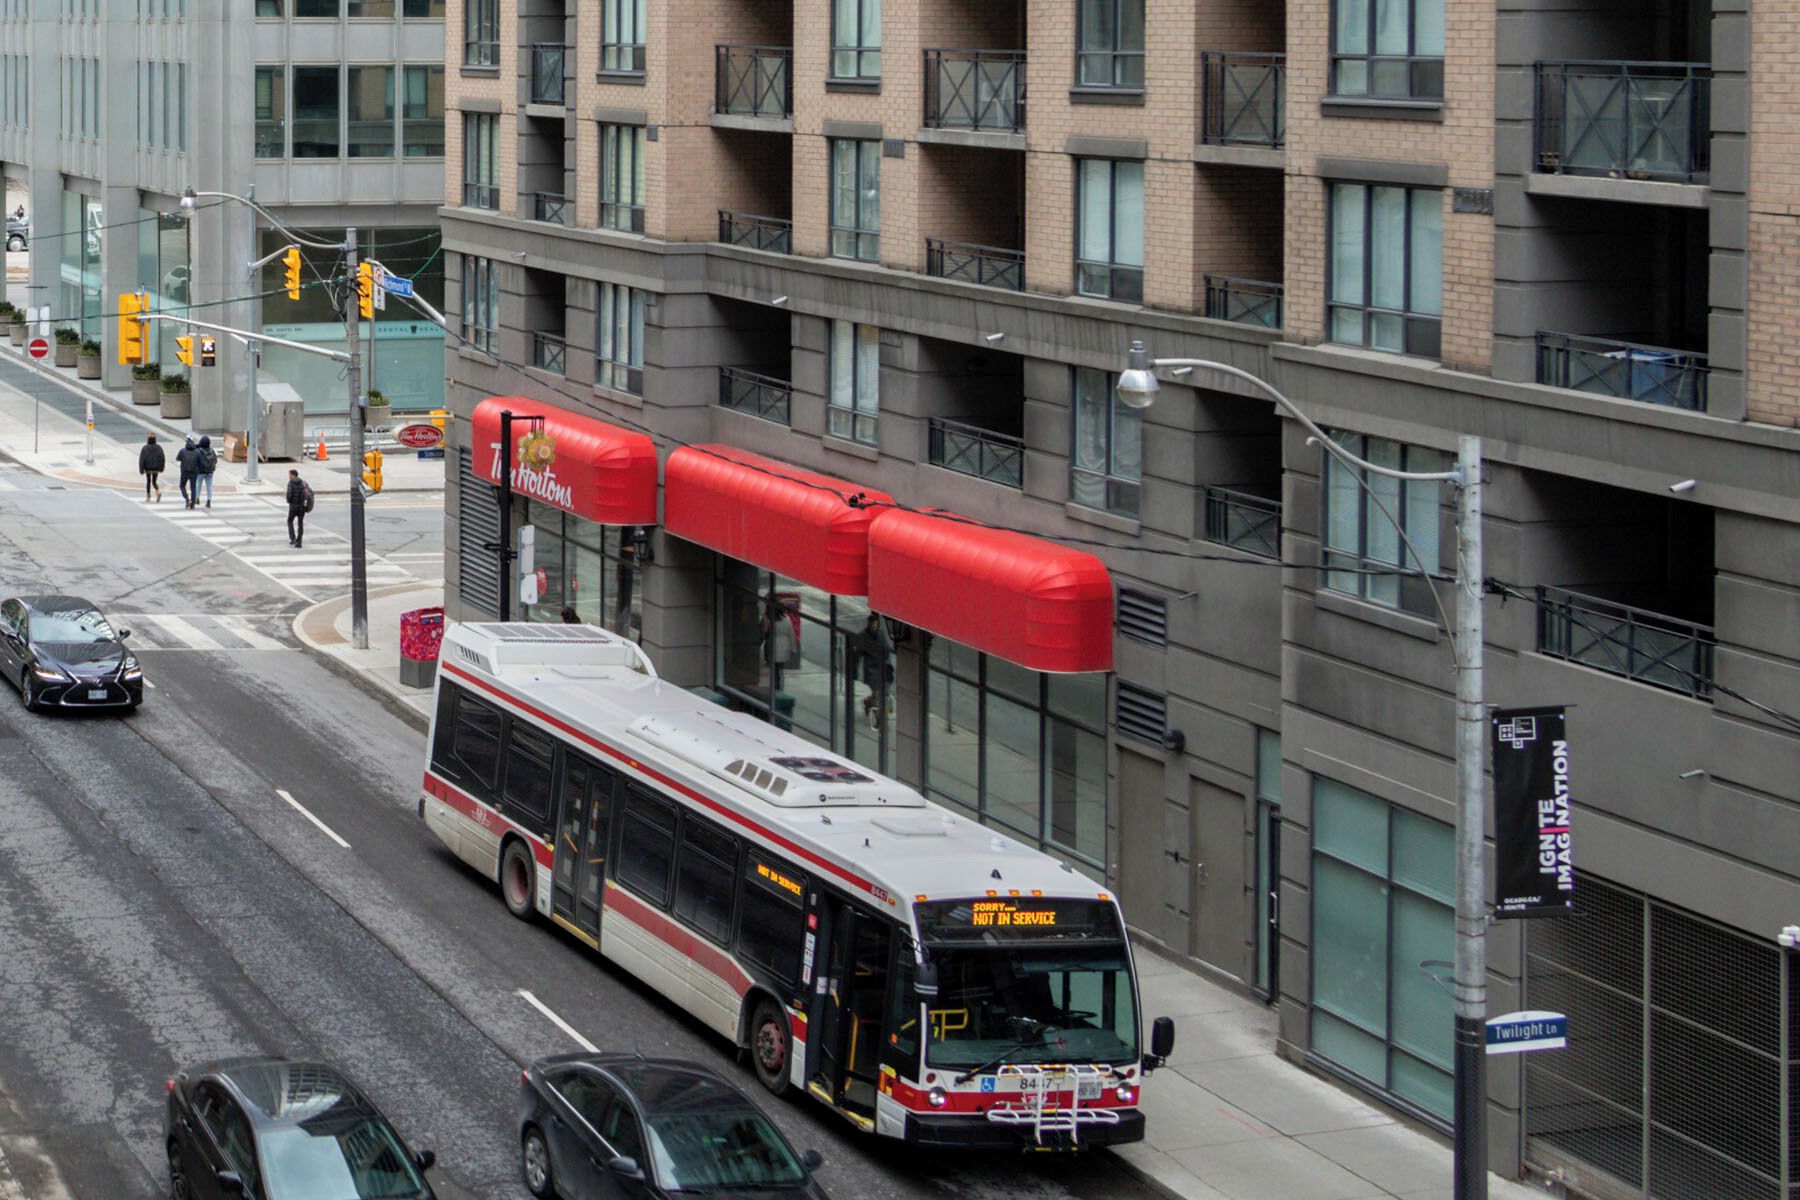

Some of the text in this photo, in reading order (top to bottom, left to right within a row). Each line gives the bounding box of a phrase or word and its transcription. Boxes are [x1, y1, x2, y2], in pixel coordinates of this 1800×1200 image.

[1538, 799, 1556, 873] IGNITE
[1553, 740, 1573, 890] IMAGINATION
[973, 912, 1056, 925] NOT IN SERVICE
[1495, 1022, 1557, 1040] Twilight Ln
